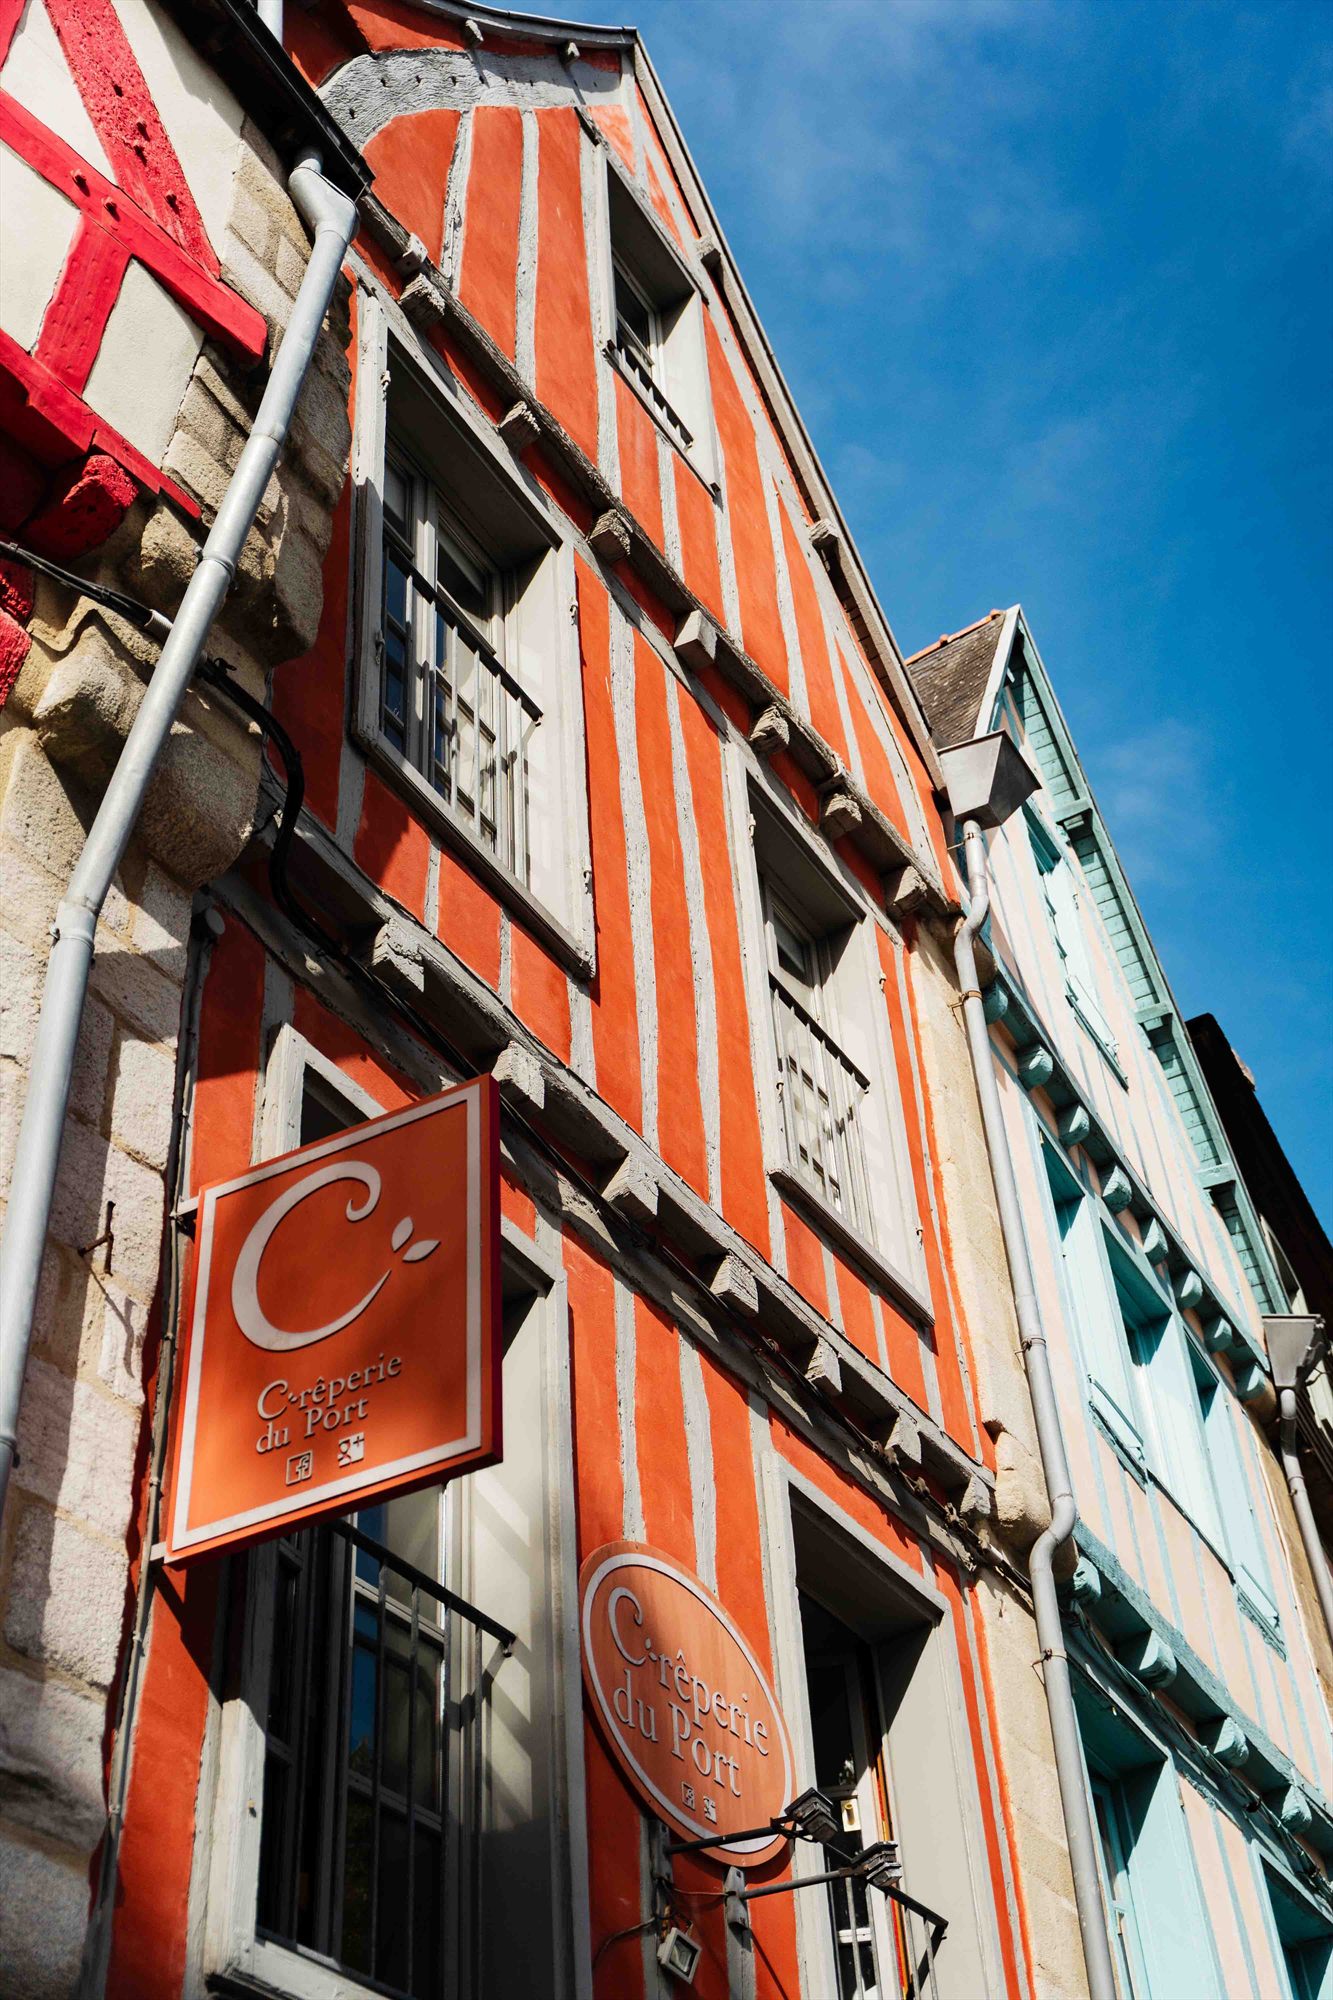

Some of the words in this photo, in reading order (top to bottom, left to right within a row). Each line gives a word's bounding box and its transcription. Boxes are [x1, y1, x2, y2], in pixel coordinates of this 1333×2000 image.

[256, 1421, 291, 1454] du
[303, 1398, 369, 1439] Port
[257, 1353, 402, 1420] Crêperie
[608, 1587, 768, 1755] Crêperie
[613, 1670, 658, 1743] du
[668, 1701, 741, 1796] Port
